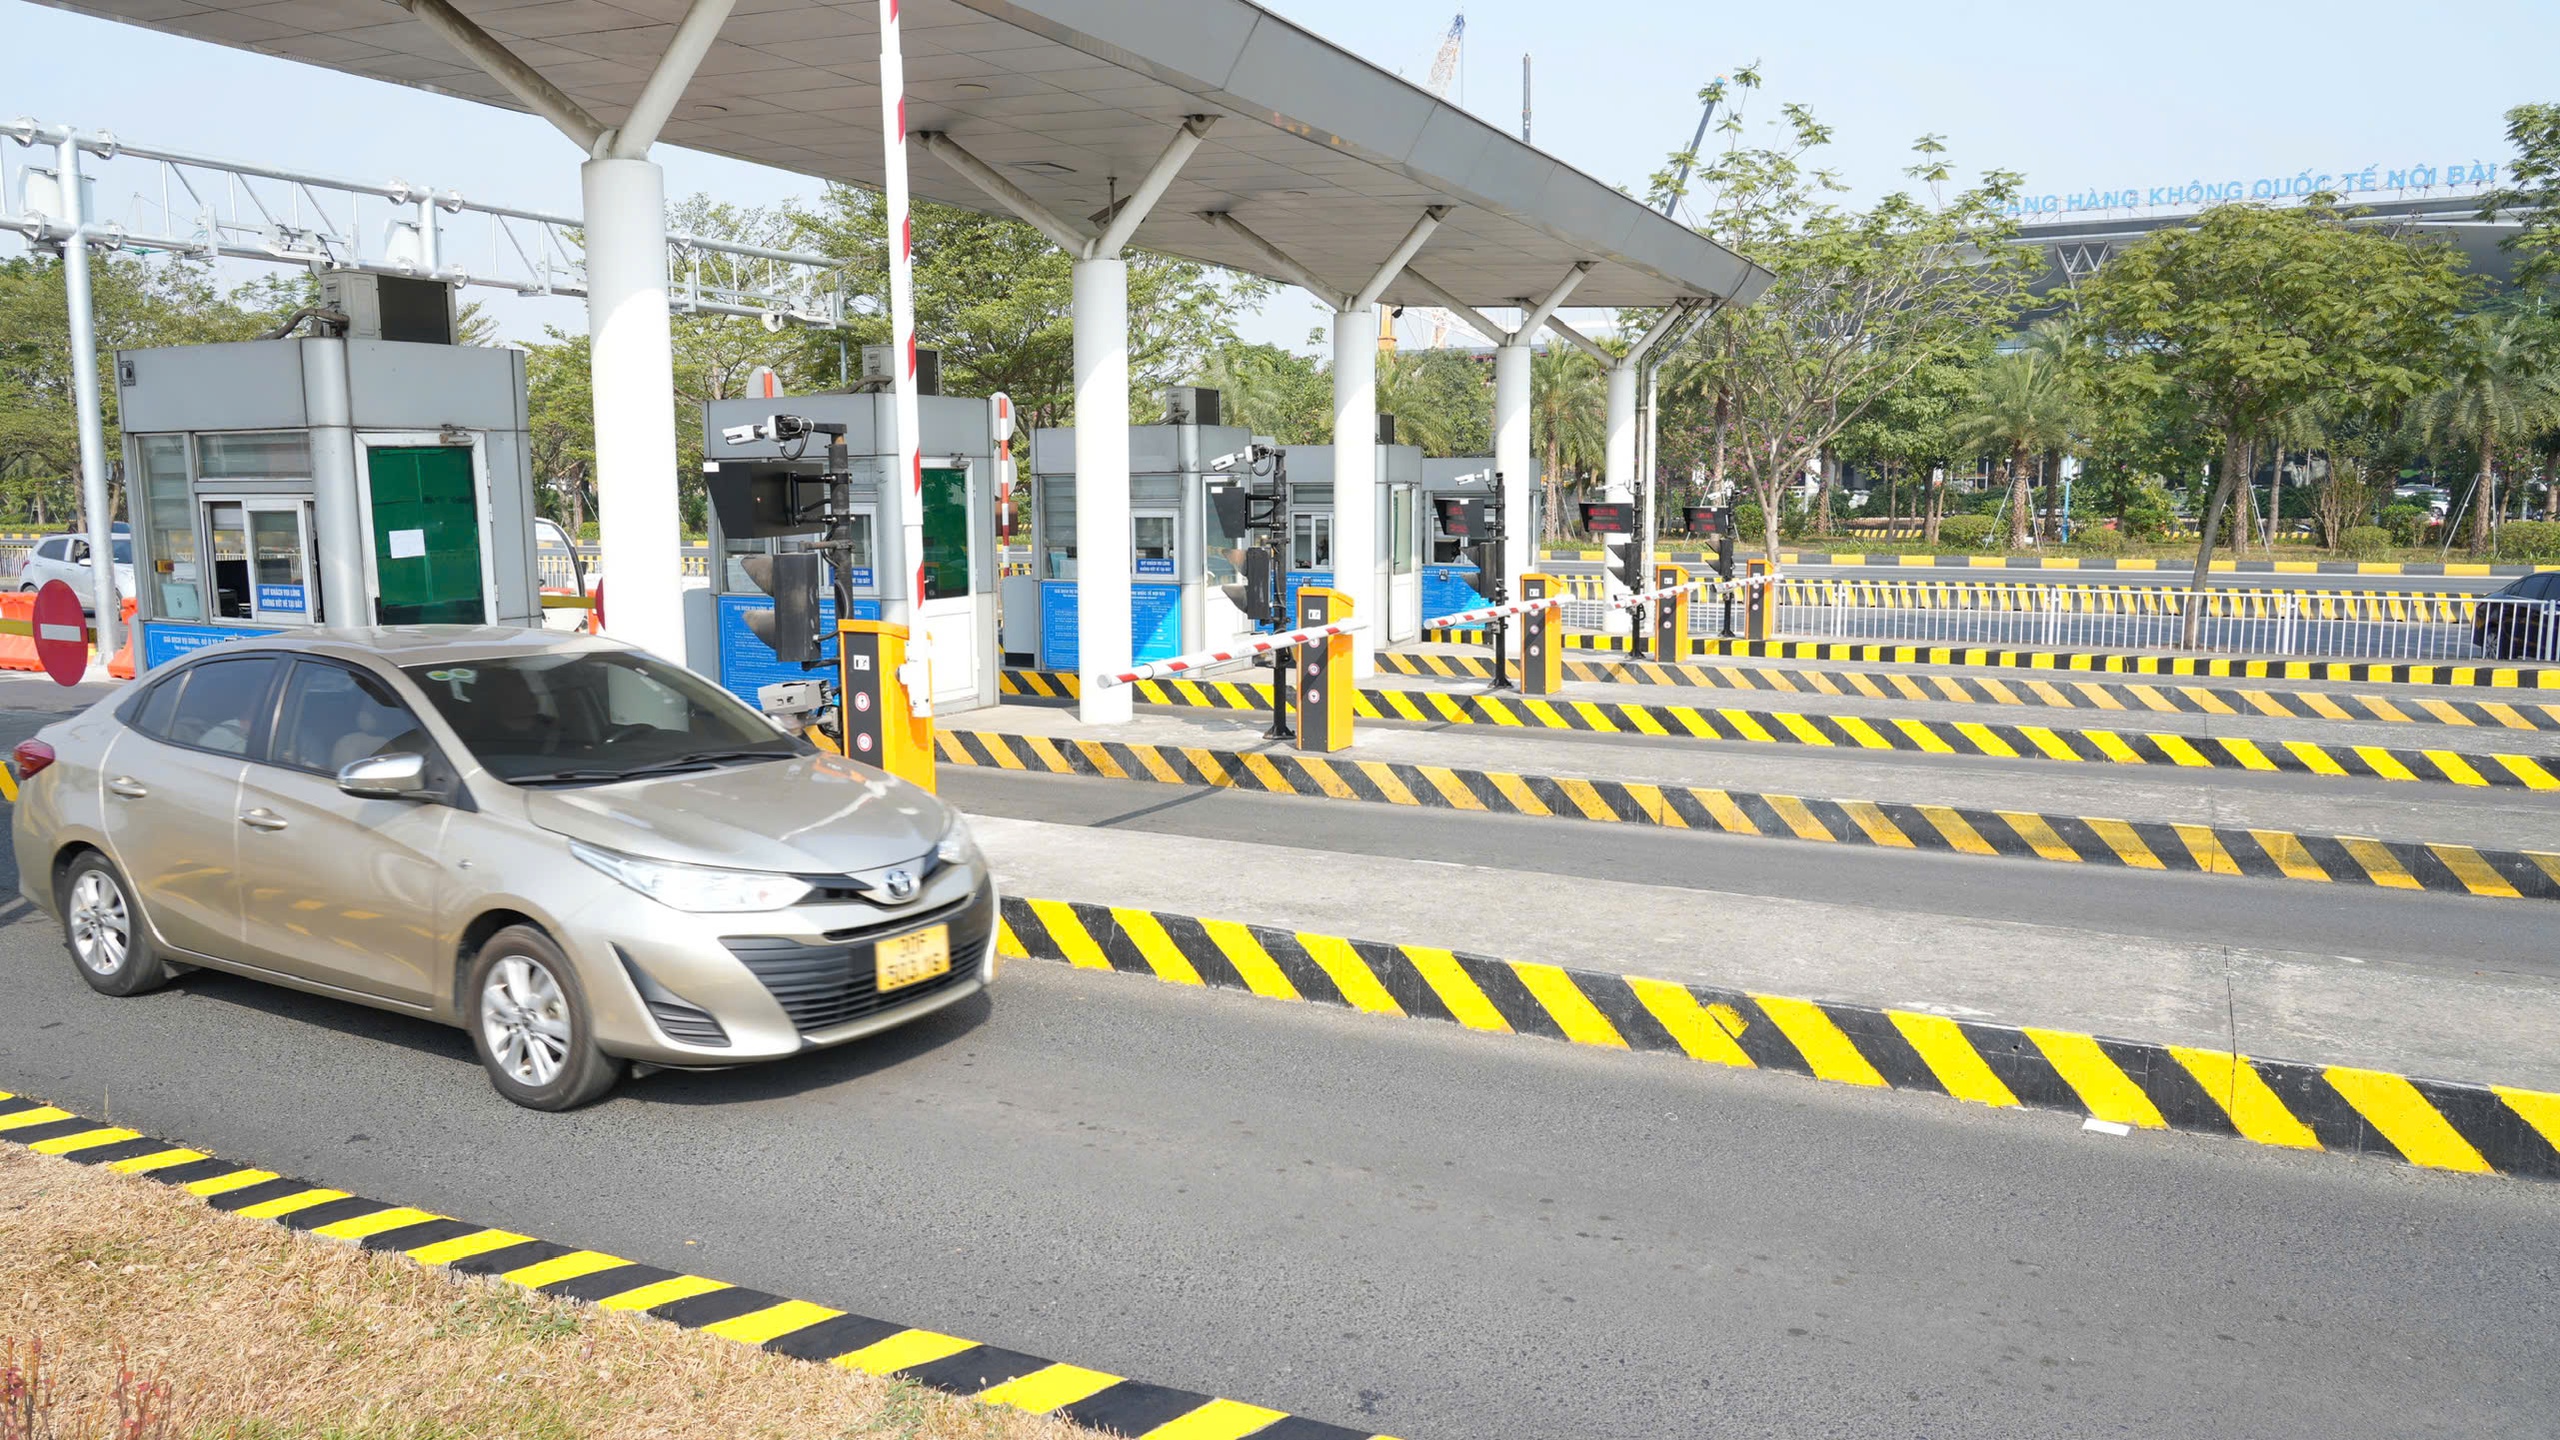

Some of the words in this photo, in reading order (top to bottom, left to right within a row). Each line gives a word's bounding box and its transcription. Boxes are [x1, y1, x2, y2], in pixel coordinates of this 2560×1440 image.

[2068, 187, 2139, 210] HÀNG
[2148, 179, 2243, 206] KHÔNG
[2251, 168, 2333, 200] QUỐC
[2342, 163, 2379, 192] TẾ
[2388, 163, 2437, 193] NỘI
[2447, 159, 2496, 186] BÀI
